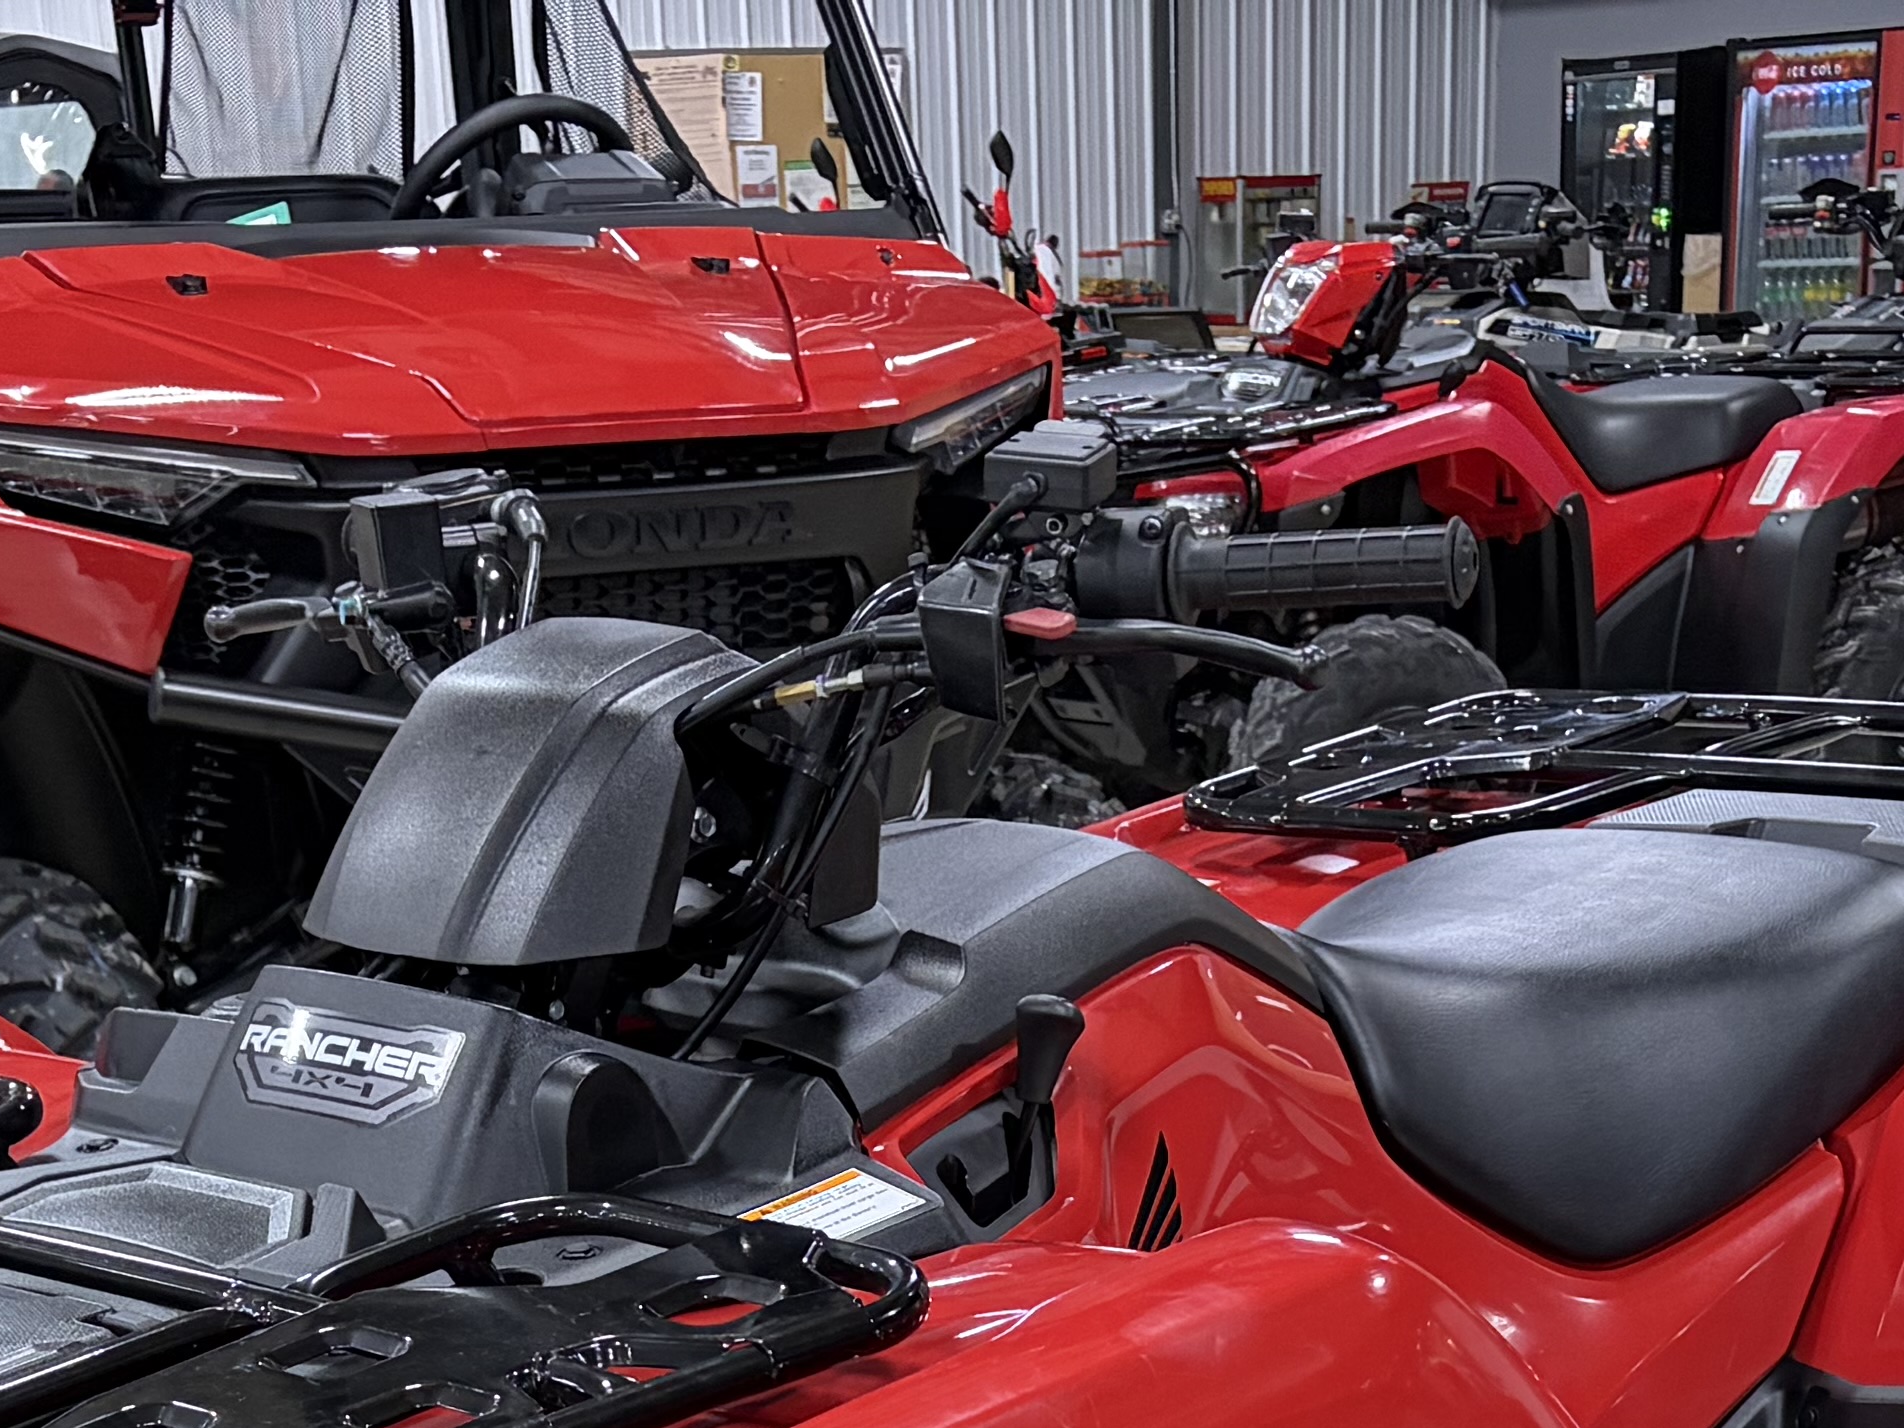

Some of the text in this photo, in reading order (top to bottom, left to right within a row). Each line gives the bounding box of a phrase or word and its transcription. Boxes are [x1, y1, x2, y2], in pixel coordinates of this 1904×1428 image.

[1810, 63, 1842, 77] COLD
[566, 500, 794, 560] ONDA
[239, 1023, 448, 1087] RANCHER
